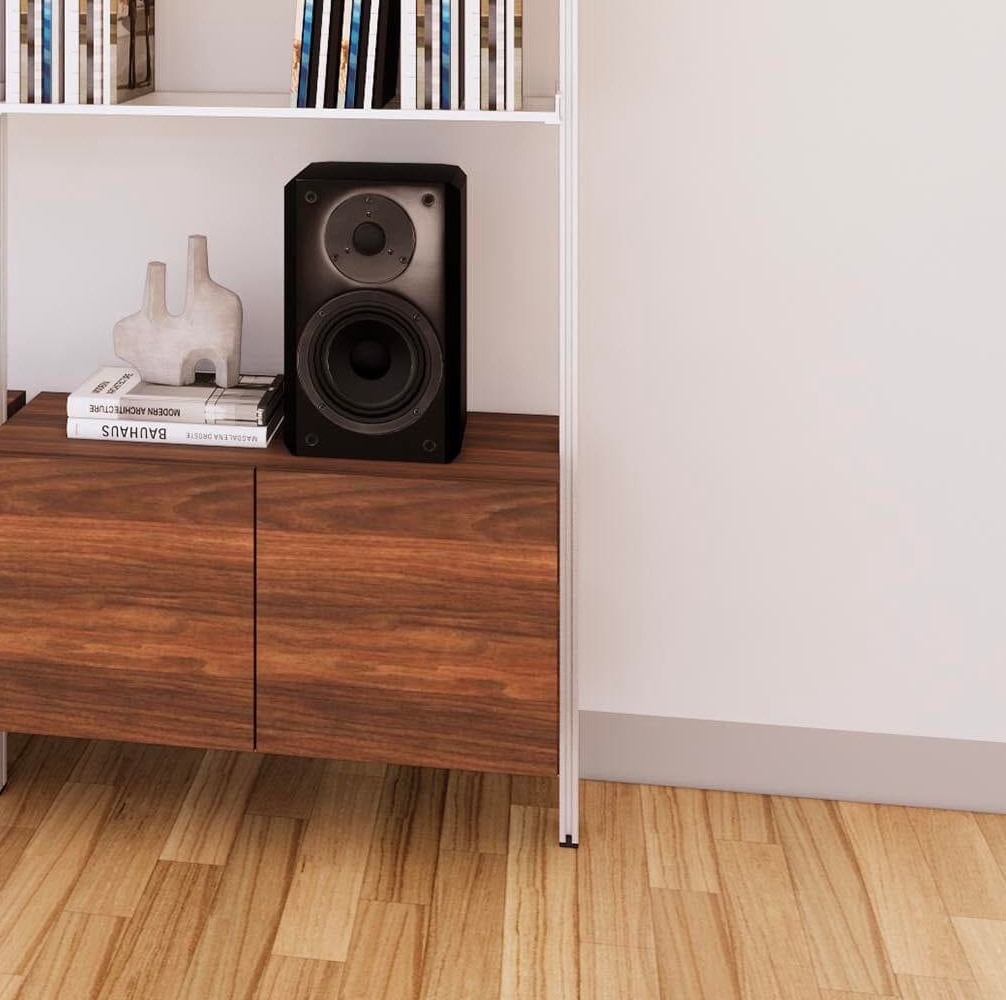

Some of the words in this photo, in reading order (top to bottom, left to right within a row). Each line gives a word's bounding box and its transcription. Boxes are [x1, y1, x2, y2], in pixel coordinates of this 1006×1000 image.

[89, 404, 146, 415] ARCHITECTURE
[147, 407, 181, 417] MODERN
[102, 424, 167, 440] BAUHAUS
